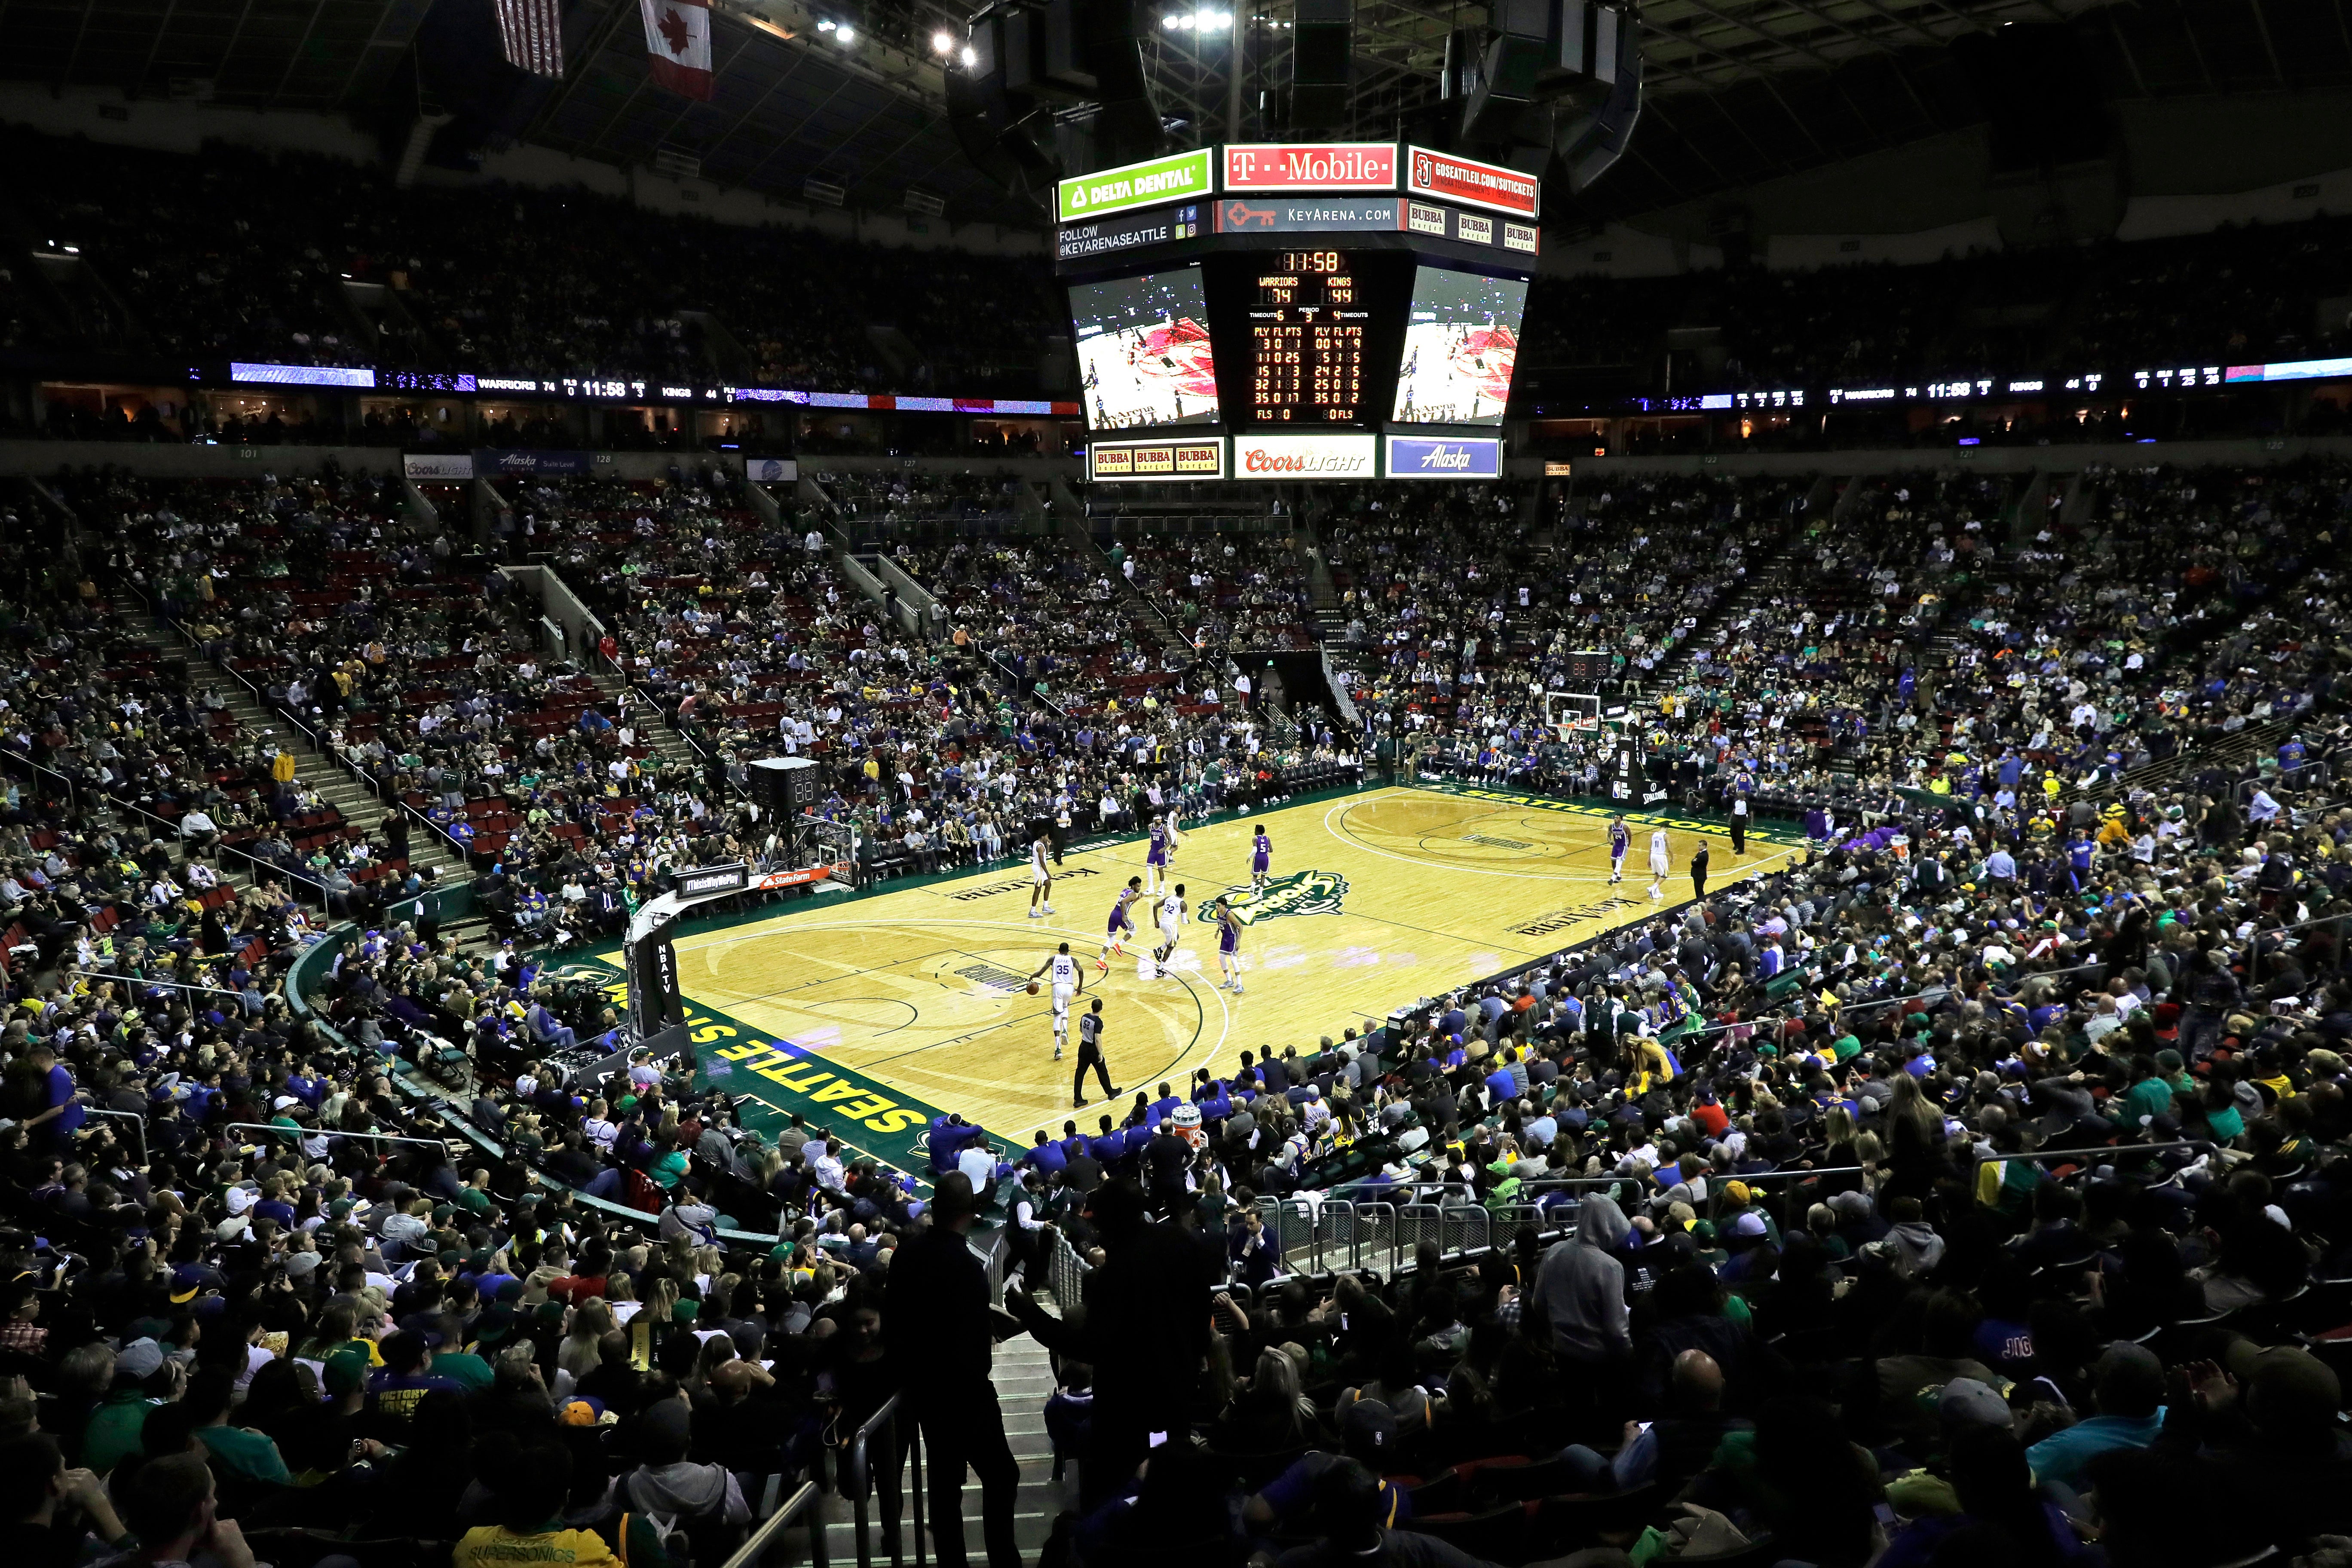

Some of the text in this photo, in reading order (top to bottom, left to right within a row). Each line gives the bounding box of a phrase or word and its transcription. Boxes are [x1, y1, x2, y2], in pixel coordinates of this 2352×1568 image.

[1435, 162, 1534, 197] GOSEATTLEU.COM/SUTICKETS
[1091, 167, 1193, 205] DELTA DENTAL
[1440, 178, 1454, 187] NCAA
[1455, 181, 1490, 196] TOURNAMENTS
[1507, 192, 1520, 202] FINAL
[1412, 208, 1442, 224] BUBBA
[1461, 218, 1489, 233] BUBBA
[1060, 225, 1098, 242] FOLLOW
[1507, 227, 1534, 242] BUBBA
[1060, 227, 1167, 255] @KEYARENASEATTLE
[1290, 252, 1338, 272] 11:58
[1259, 277, 1298, 287] WARRIORS
[1327, 277, 1351, 287] KINGS
[1273, 288, 1291, 303] 74
[1332, 289, 1351, 303] 44
[1277, 310, 1284, 321] 6
[1306, 312, 1312, 322] 3
[1334, 311, 1341, 320] 4
[1255, 327, 1302, 336] PLY FL PTS
[1315, 327, 1362, 336] PLY FL PTS
[1264, 338, 1270, 349] 3
[1275, 338, 1282, 349] 0
[1316, 338, 1330, 349] 00
[1335, 338, 1342, 349] 4
[1259, 352, 1300, 363] 11 0 25
[1323, 352, 1330, 363] 5
[1354, 352, 1360, 363] 5
[1259, 365, 1269, 377] 15
[1293, 365, 1299, 377] 3
[1315, 365, 1359, 377] 24 2 5
[478, 379, 555, 391] WARRIORS 74
[1256, 379, 1268, 390] 32
[1293, 379, 1299, 390] 3
[1314, 379, 1359, 390] 25 0 6
[2009, 379, 2079, 391] KINGS 44
[2089, 382, 2097, 391] 0
[2139, 379, 2147, 388] 0
[2162, 378, 2168, 386] 1
[568, 387, 574, 396] 0
[583, 381, 625, 396] 11:58
[637, 389, 643, 397] 3
[662, 388, 716, 398] KINGS 44
[1905, 388, 1917, 397] 74
[1928, 382, 1970, 398] 11:58
[727, 395, 732, 403] 0
[1256, 392, 1298, 403] 35 0 17
[1315, 392, 1358, 403] 35 0 2
[1844, 389, 1895, 400] WARRIORS
[1257, 409, 1290, 420] FLS 0
[1329, 409, 1353, 420] 0 FLS
[240, 449, 257, 458] 101
[1098, 453, 1129, 463] BUBBA
[1137, 452, 1170, 462] BUBBA
[1179, 450, 1214, 461] BUBBA
[1421, 444, 1470, 469] Alaska
[499, 453, 536, 466] Alaska
[1246, 449, 1366, 472] Coors LIGHT
[405, 462, 440, 475] Coors
[1643, 789, 1667, 804] SPALDING
[1458, 789, 1616, 818] SEATTLE
[1625, 810, 1771, 840] STORM
[1260, 844, 1266, 852] 5
[686, 874, 738, 891] #ThisIsWhyWePlay
[1280, 891, 1315, 912] SEATTLE
[1165, 903, 1175, 914] 32
[1516, 897, 1644, 936] KeyArena
[1535, 909, 1568, 922] Seattle
[1502, 921, 1537, 932] Center
[658, 944, 671, 993] NBA TV
[1057, 965, 1069, 974] 35
[1083, 1020, 1090, 1030] 52
[714, 1039, 927, 1133] SEATTLE
[1367, 1117, 1379, 1134] 35
[380, 1389, 429, 1400] VICTORY
[469, 1547, 576, 1564] SUPERSONICS
